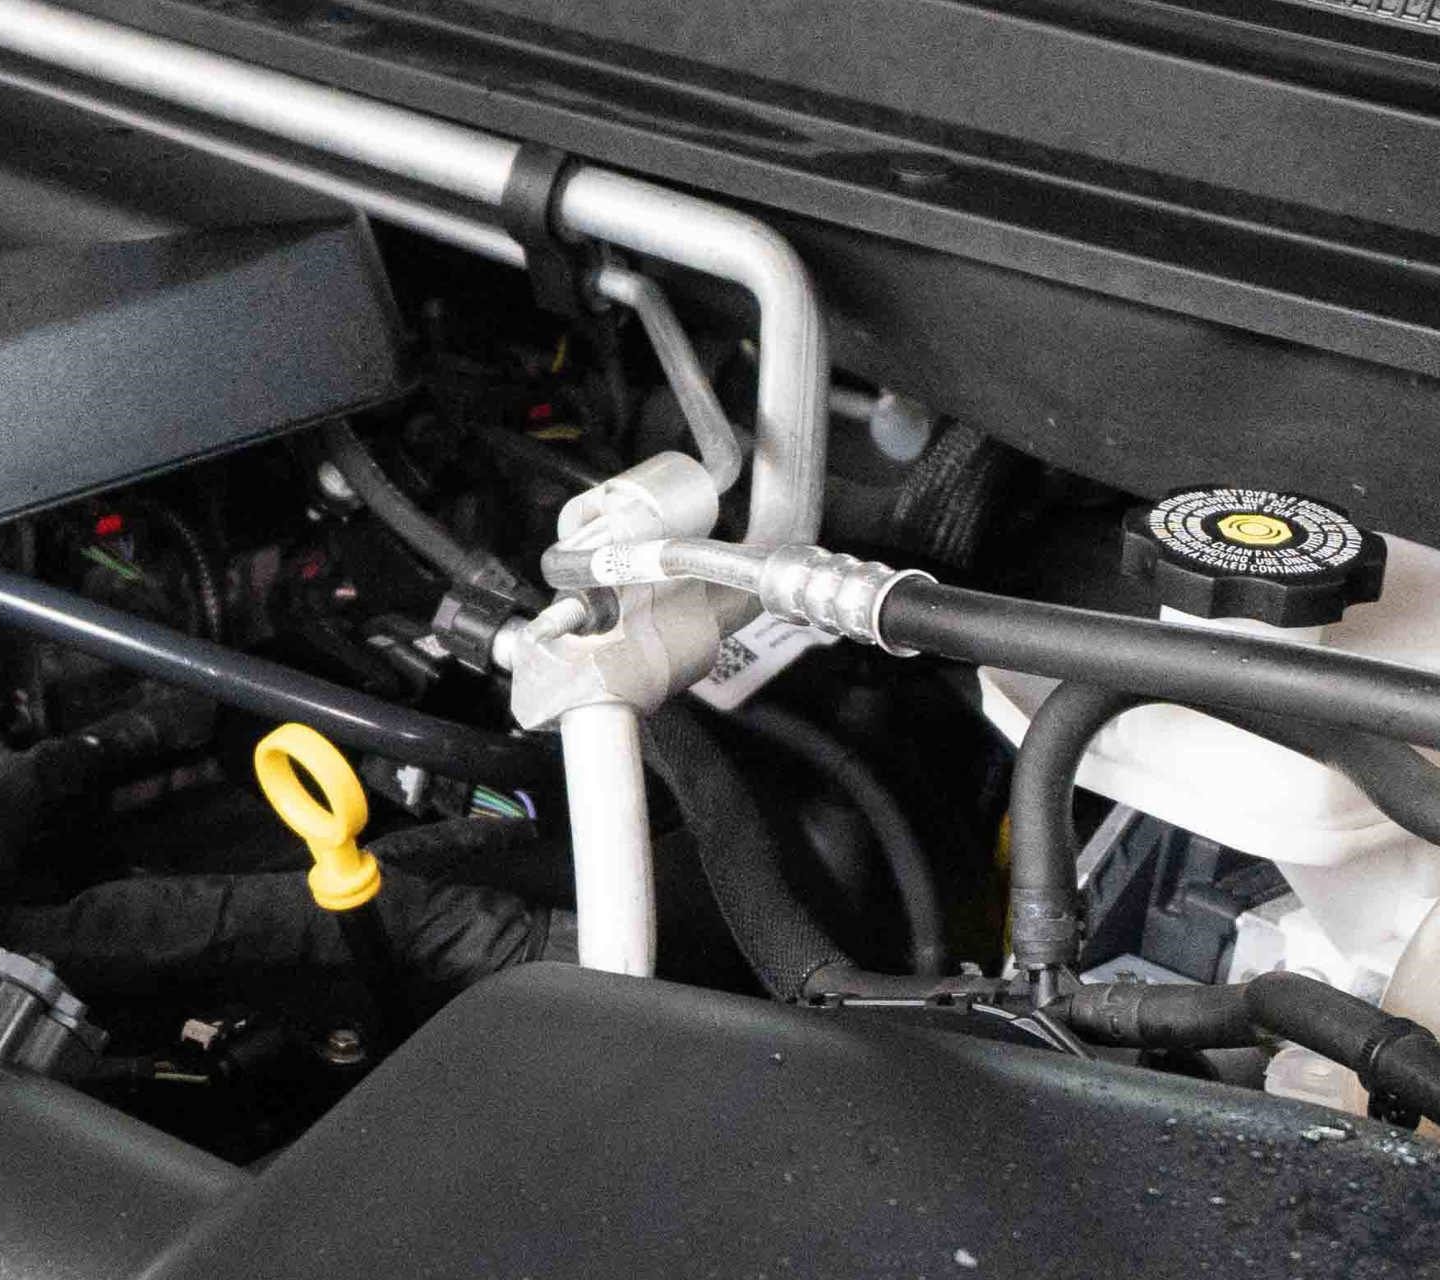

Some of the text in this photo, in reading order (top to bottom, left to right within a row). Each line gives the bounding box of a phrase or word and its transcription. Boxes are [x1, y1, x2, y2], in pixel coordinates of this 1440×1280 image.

[1211, 541, 1253, 557] CLEAN
[1255, 548, 1301, 558] FILLER
[1199, 554, 1247, 571] SEALED
[1255, 557, 1280, 566] USE
[1282, 555, 1313, 565] ONLY
